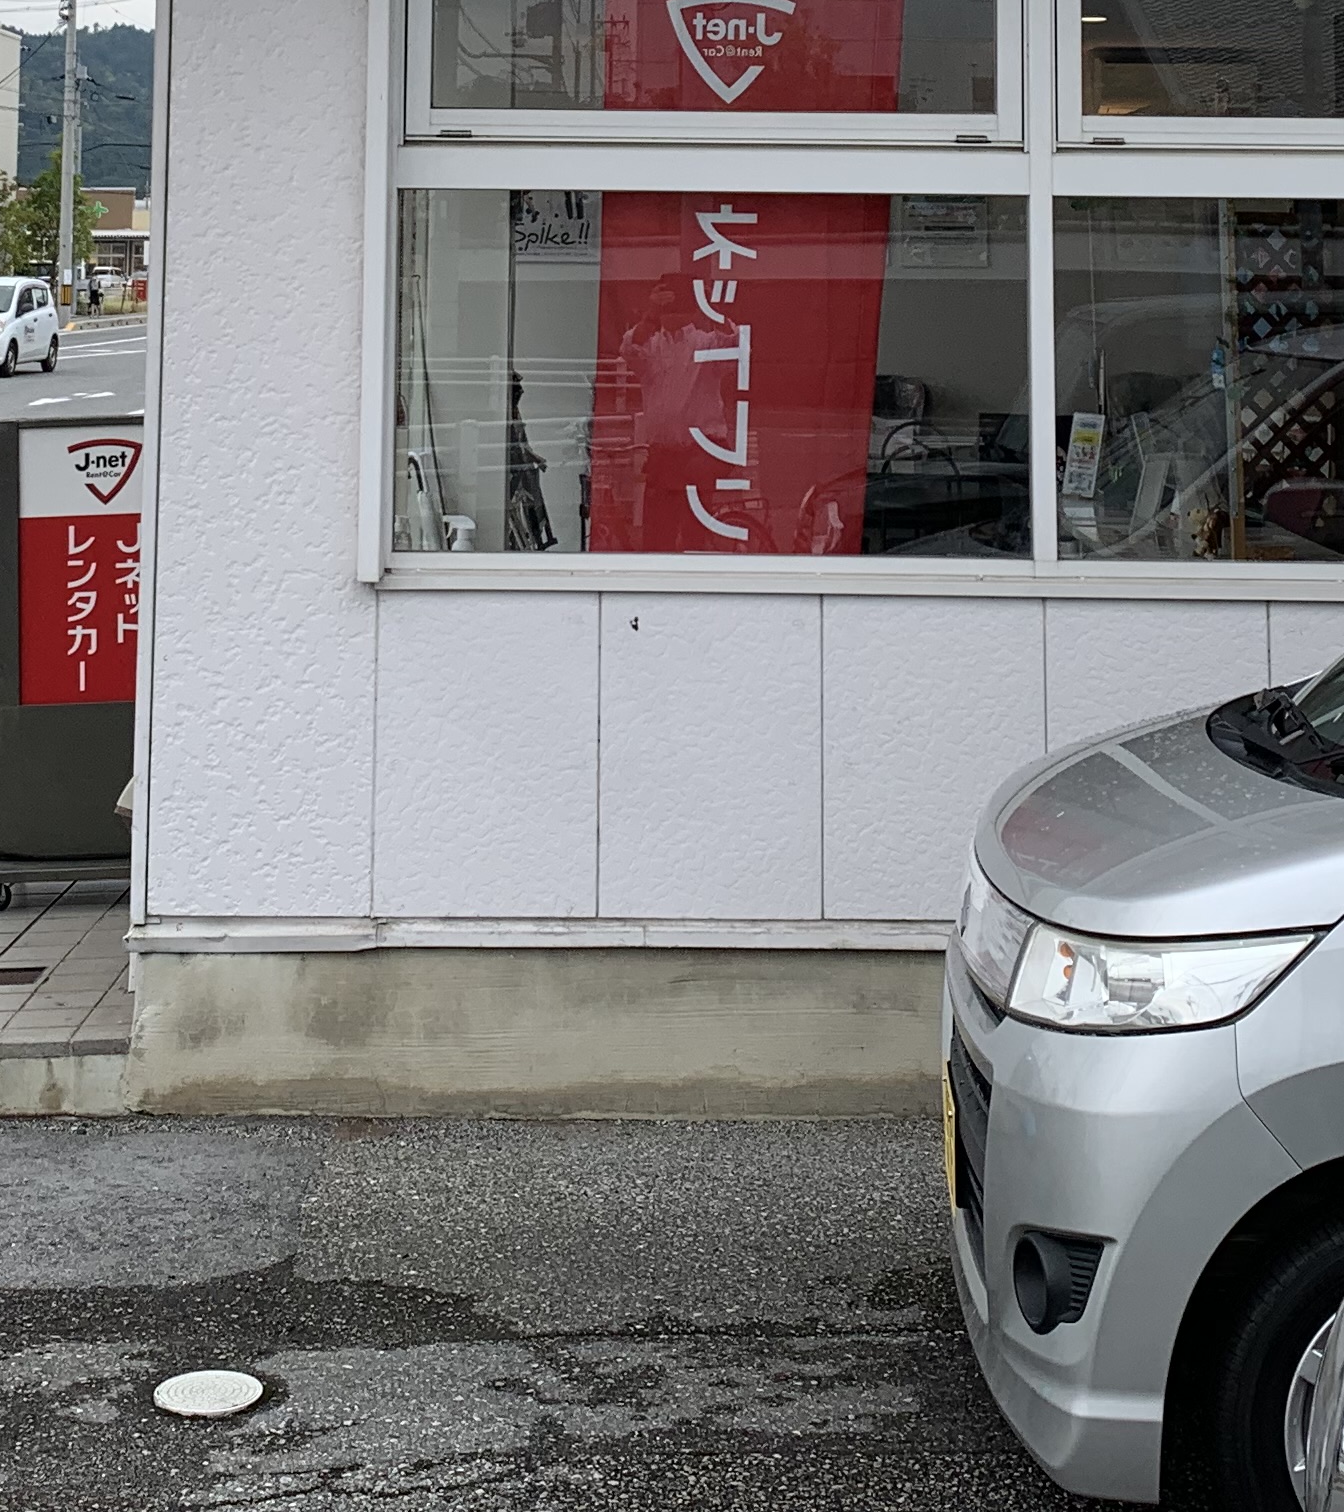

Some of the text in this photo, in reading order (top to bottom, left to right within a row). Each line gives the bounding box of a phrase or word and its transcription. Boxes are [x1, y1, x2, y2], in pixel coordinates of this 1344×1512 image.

[67, 524, 98, 692] レンタカー
